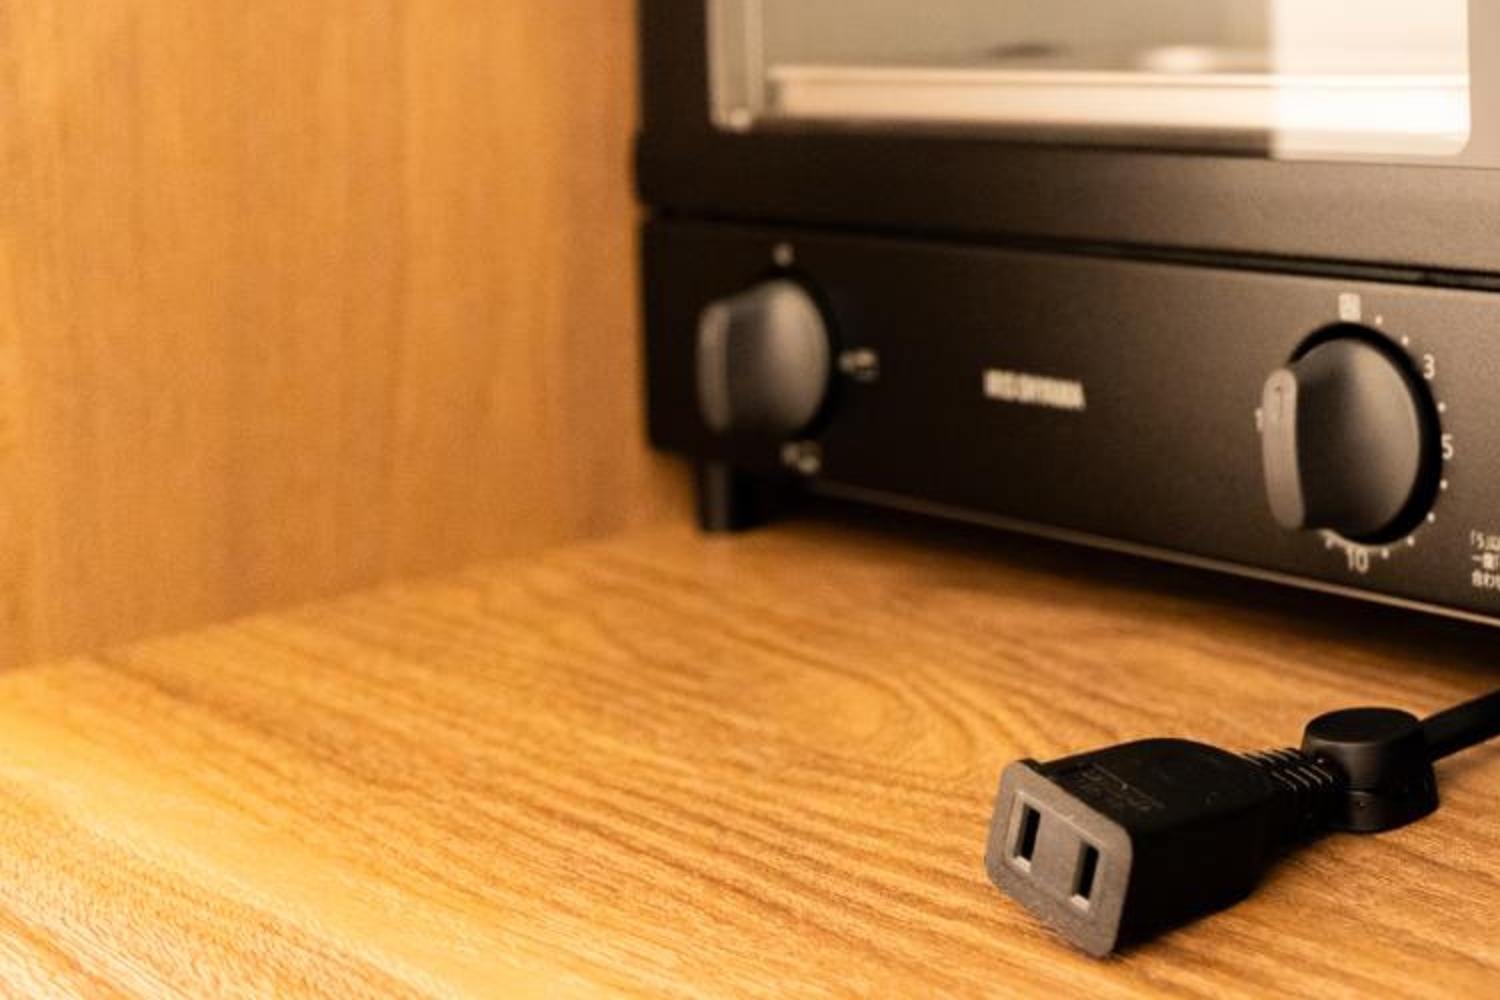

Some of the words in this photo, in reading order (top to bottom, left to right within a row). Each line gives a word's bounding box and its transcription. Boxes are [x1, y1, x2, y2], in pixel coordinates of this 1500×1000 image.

[1423, 353, 1436, 379] 3
[1441, 434, 1454, 459] 5
[1347, 546, 1369, 573] 10
